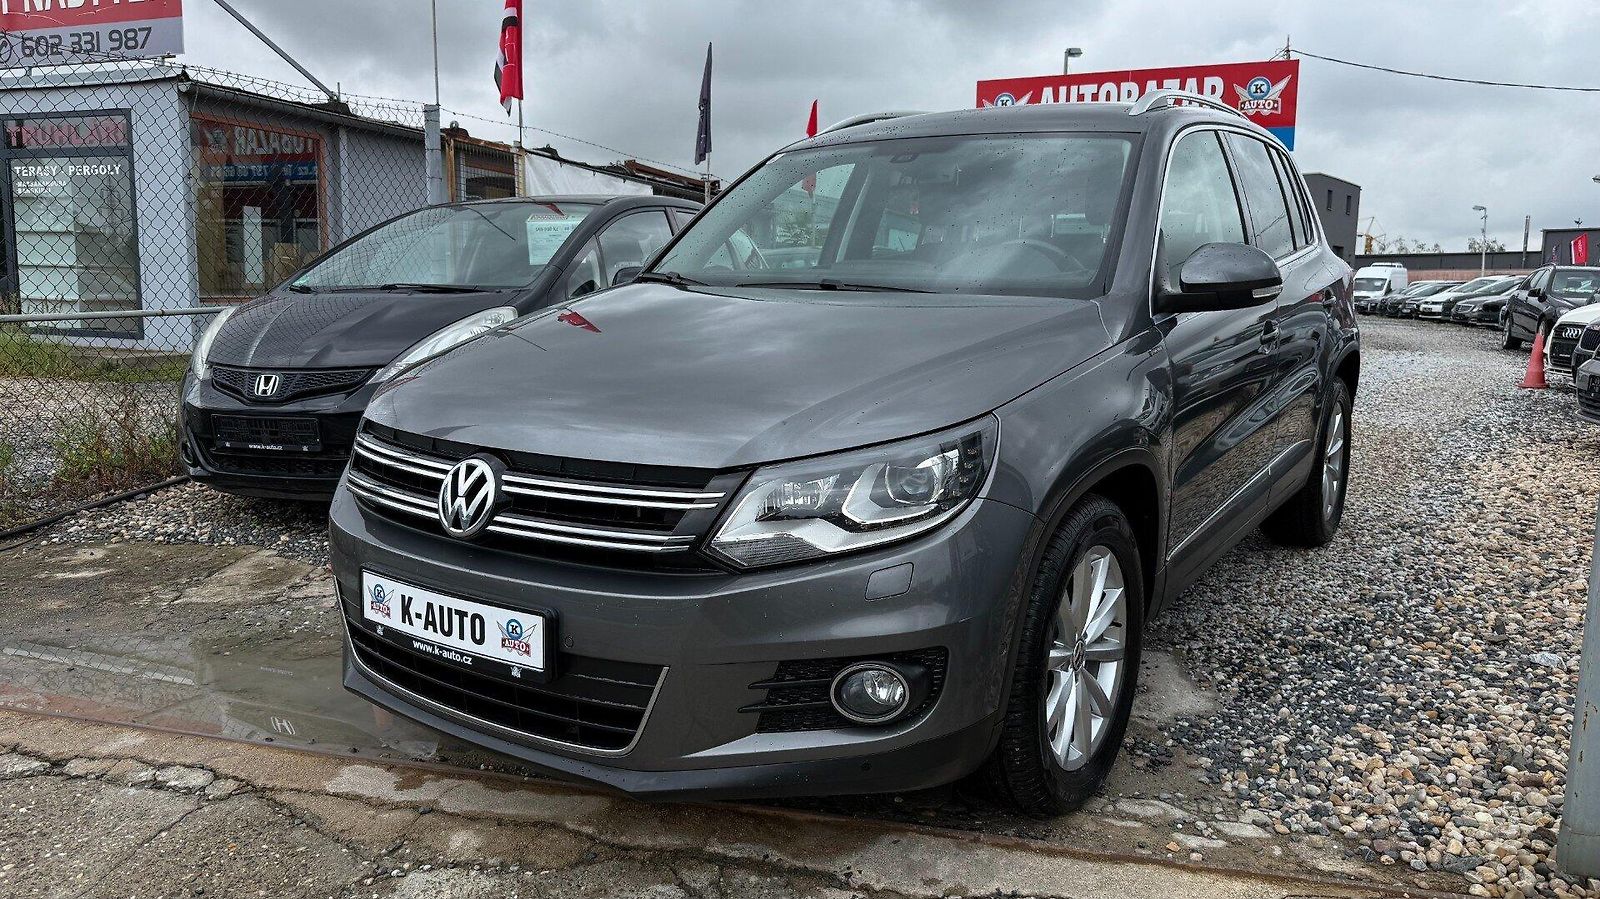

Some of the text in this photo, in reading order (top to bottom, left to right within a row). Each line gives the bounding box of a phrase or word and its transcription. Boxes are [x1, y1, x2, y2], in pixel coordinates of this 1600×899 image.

[21, 26, 152, 58] 602 331 987
[1253, 83, 1265, 94] K
[1245, 101, 1274, 110] AUTO
[14, 164, 121, 177] TERASY PERGOLY
[400, 593, 486, 646] K-AUTO
[509, 624, 519, 635] K
[504, 639, 526, 652] AUTO
[412, 639, 473, 666] www.k-auto.cz
